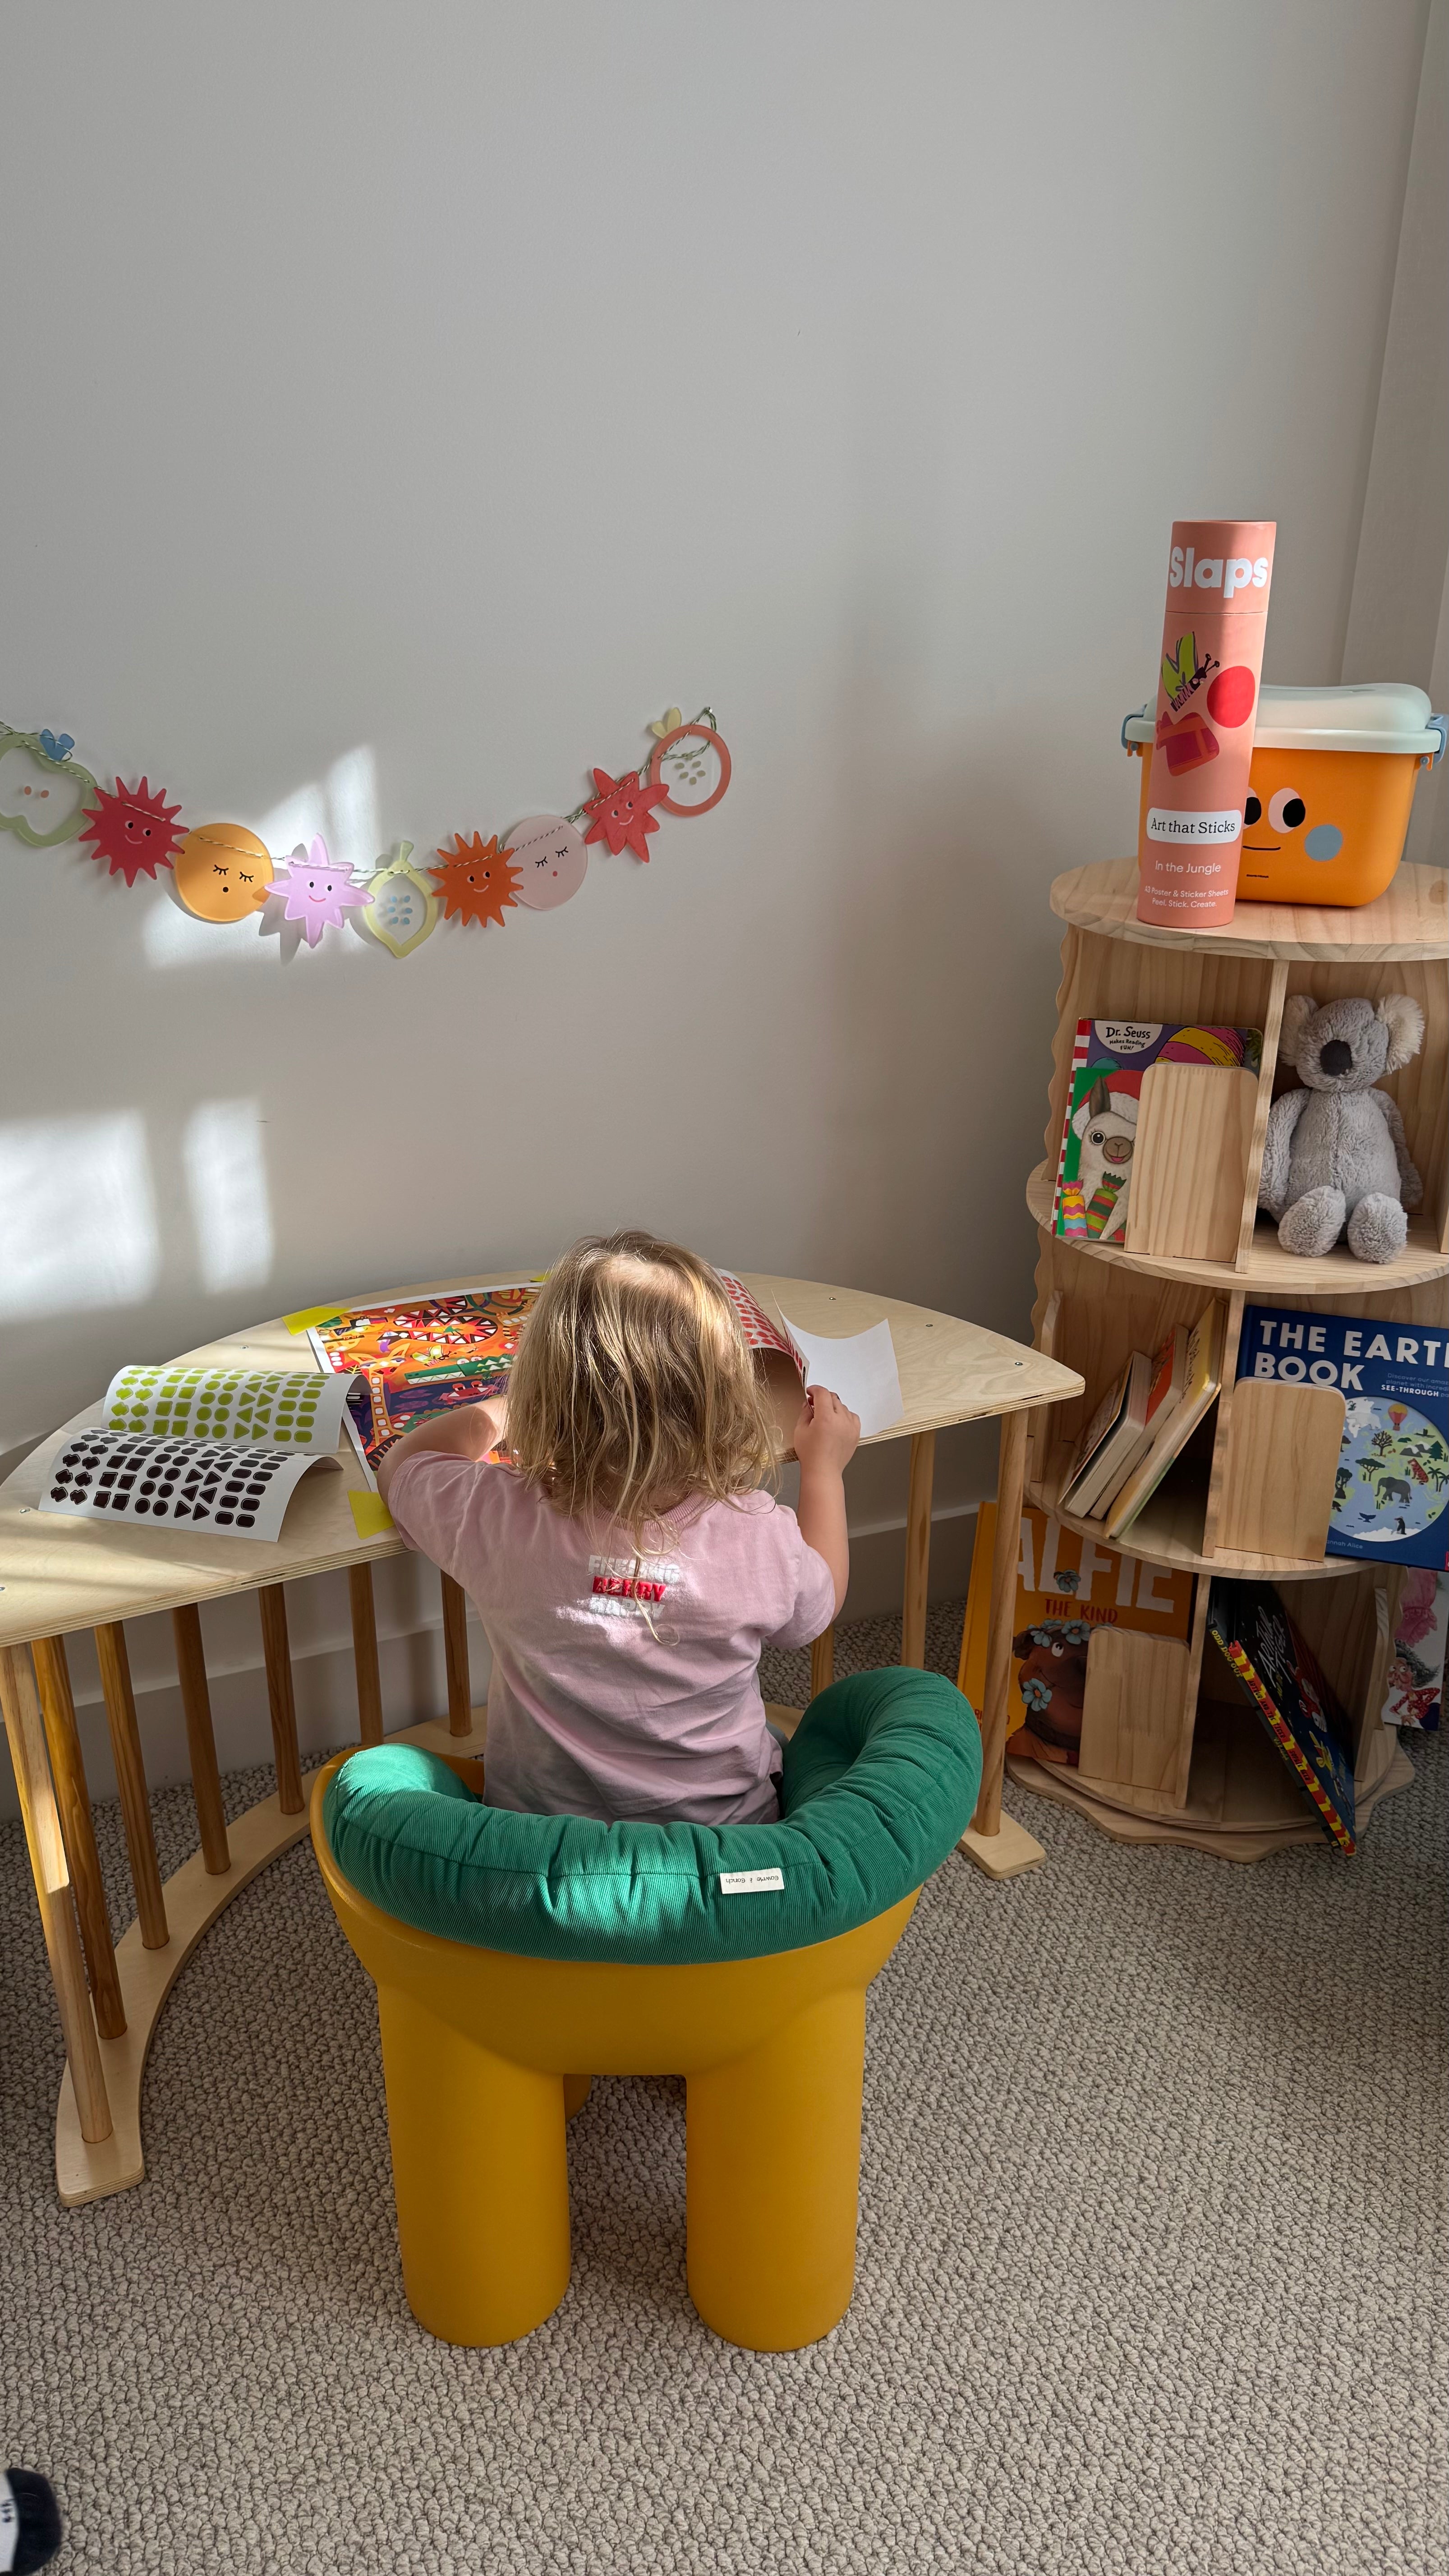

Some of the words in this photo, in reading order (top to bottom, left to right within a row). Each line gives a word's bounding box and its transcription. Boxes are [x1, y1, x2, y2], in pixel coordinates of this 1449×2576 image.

[1170, 546, 1269, 598] Slaps
[1151, 818, 1166, 832] Art
[1168, 820, 1196, 833] that
[1198, 820, 1235, 833] Sticks
[1155, 860, 1163, 870] In
[1166, 862, 1183, 873] the
[1186, 863, 1221, 875] Jungle
[1151, 887, 1171, 897] Poster
[1208, 889, 1229, 897] Sheets
[1152, 897, 1166, 906] Peel.
[1168, 900, 1189, 908] Stick.
[1106, 1027, 1121, 1038] Dr.
[1123, 1026, 1151, 1039] Seuss
[1126, 1039, 1146, 1048] Reading
[1260, 1320, 1326, 1352] THE
[1254, 1352, 1365, 1391] BOOK
[1381, 1384, 1439, 1397] SEE-THROUGH
[1045, 1599, 1072, 1617] THE
[1080, 1604, 1118, 1624] KIND
[1212, 1630, 1224, 1646] ODD
[1220, 1647, 1233, 1662] DOG
[1231, 1663, 1243, 1678] OUT
